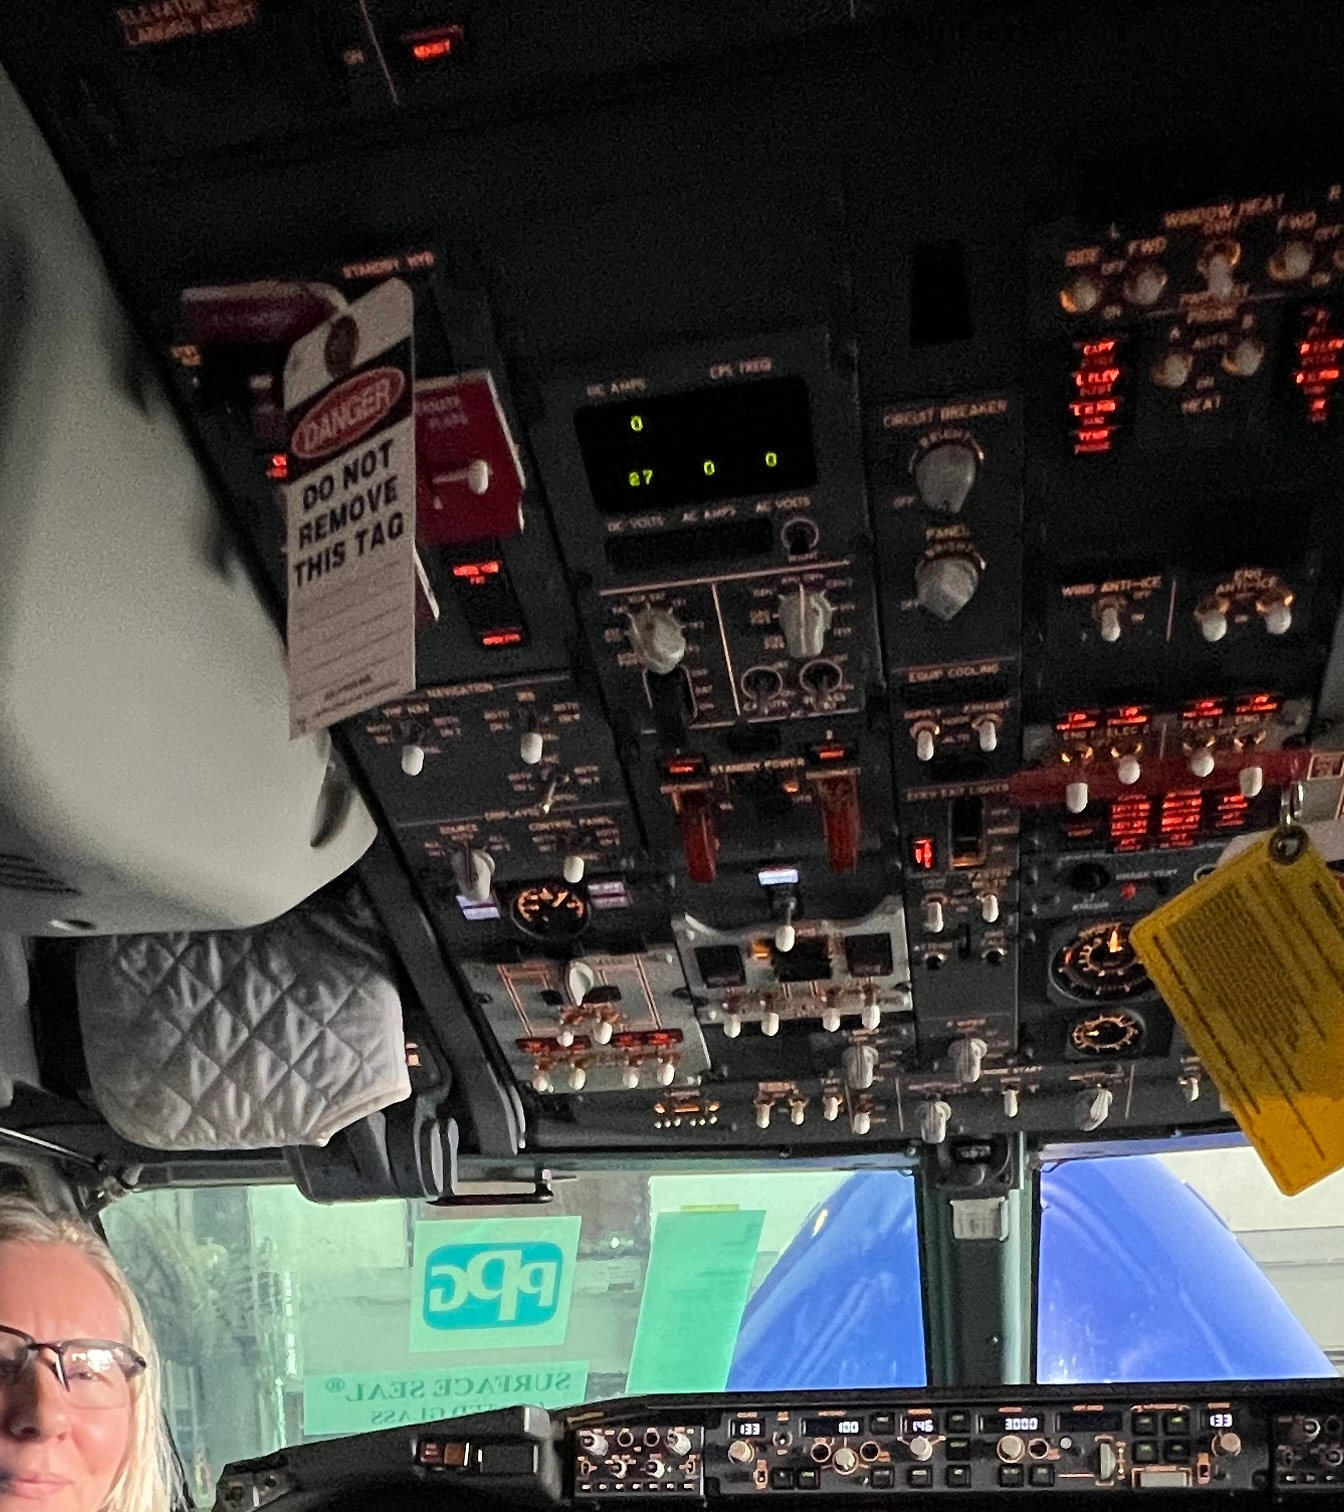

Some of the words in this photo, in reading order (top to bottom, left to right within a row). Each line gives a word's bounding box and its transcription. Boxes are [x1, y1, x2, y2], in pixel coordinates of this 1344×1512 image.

[303, 376, 393, 448] DANGER
[629, 414, 644, 433] 0
[301, 475, 335, 514] DO
[342, 439, 394, 491] NOT
[702, 459, 716, 477] 0
[764, 451, 778, 468] 0
[297, 475, 399, 550] REMOVE
[292, 542, 347, 588] THIS
[355, 511, 404, 556] TAG
